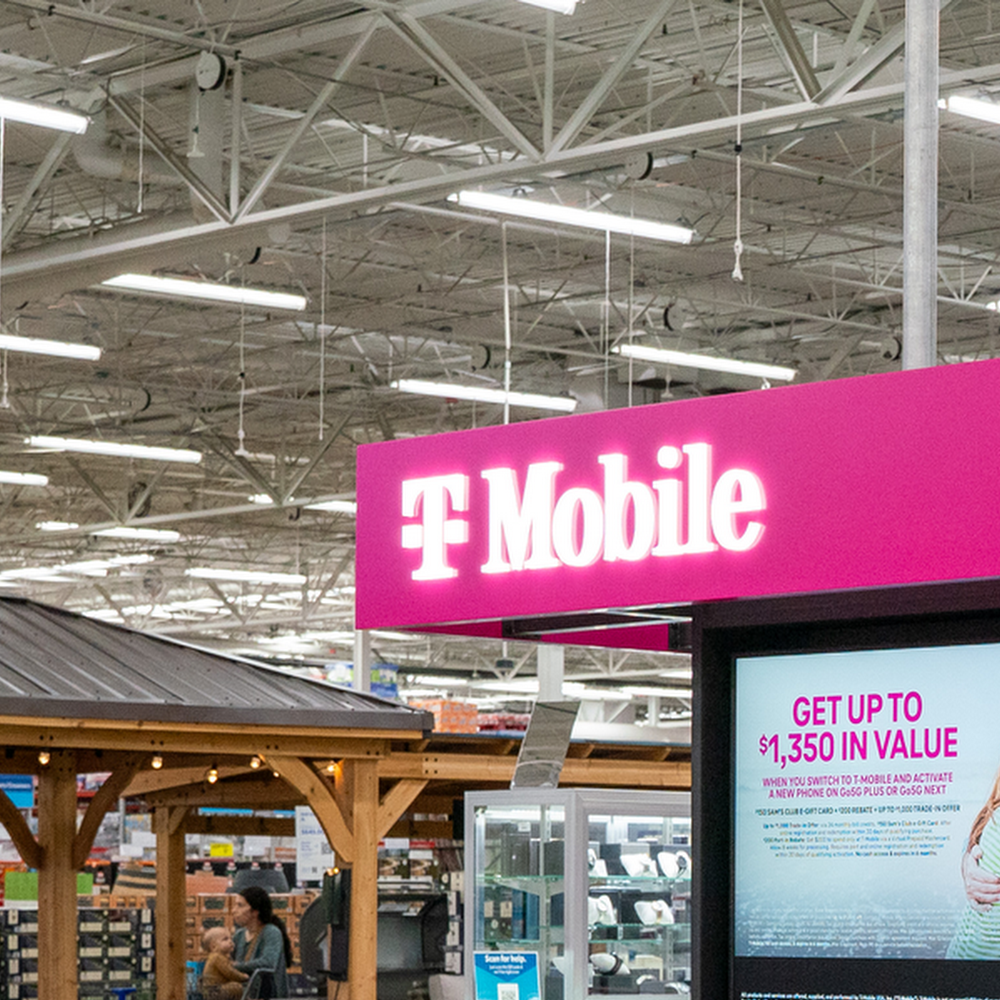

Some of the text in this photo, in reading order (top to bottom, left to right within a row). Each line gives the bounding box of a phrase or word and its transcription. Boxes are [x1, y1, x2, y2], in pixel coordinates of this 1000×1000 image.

[401, 443, 767, 581] T Mobile
[793, 691, 923, 727] GET UP TO
[759, 727, 958, 769] $1,350 IN VALUE
[762, 772, 954, 787] WHEN YOU SWITCH TO T-MOBILE AND ACTIVATE
[768, 789, 775, 799] A
[775, 788, 795, 799] NEW
[796, 787, 824, 798] PHONE
[826, 787, 838, 797] ON
[864, 786, 884, 796] PLUS
[886, 785, 898, 796] OR
[924, 784, 947, 795] NEXT
